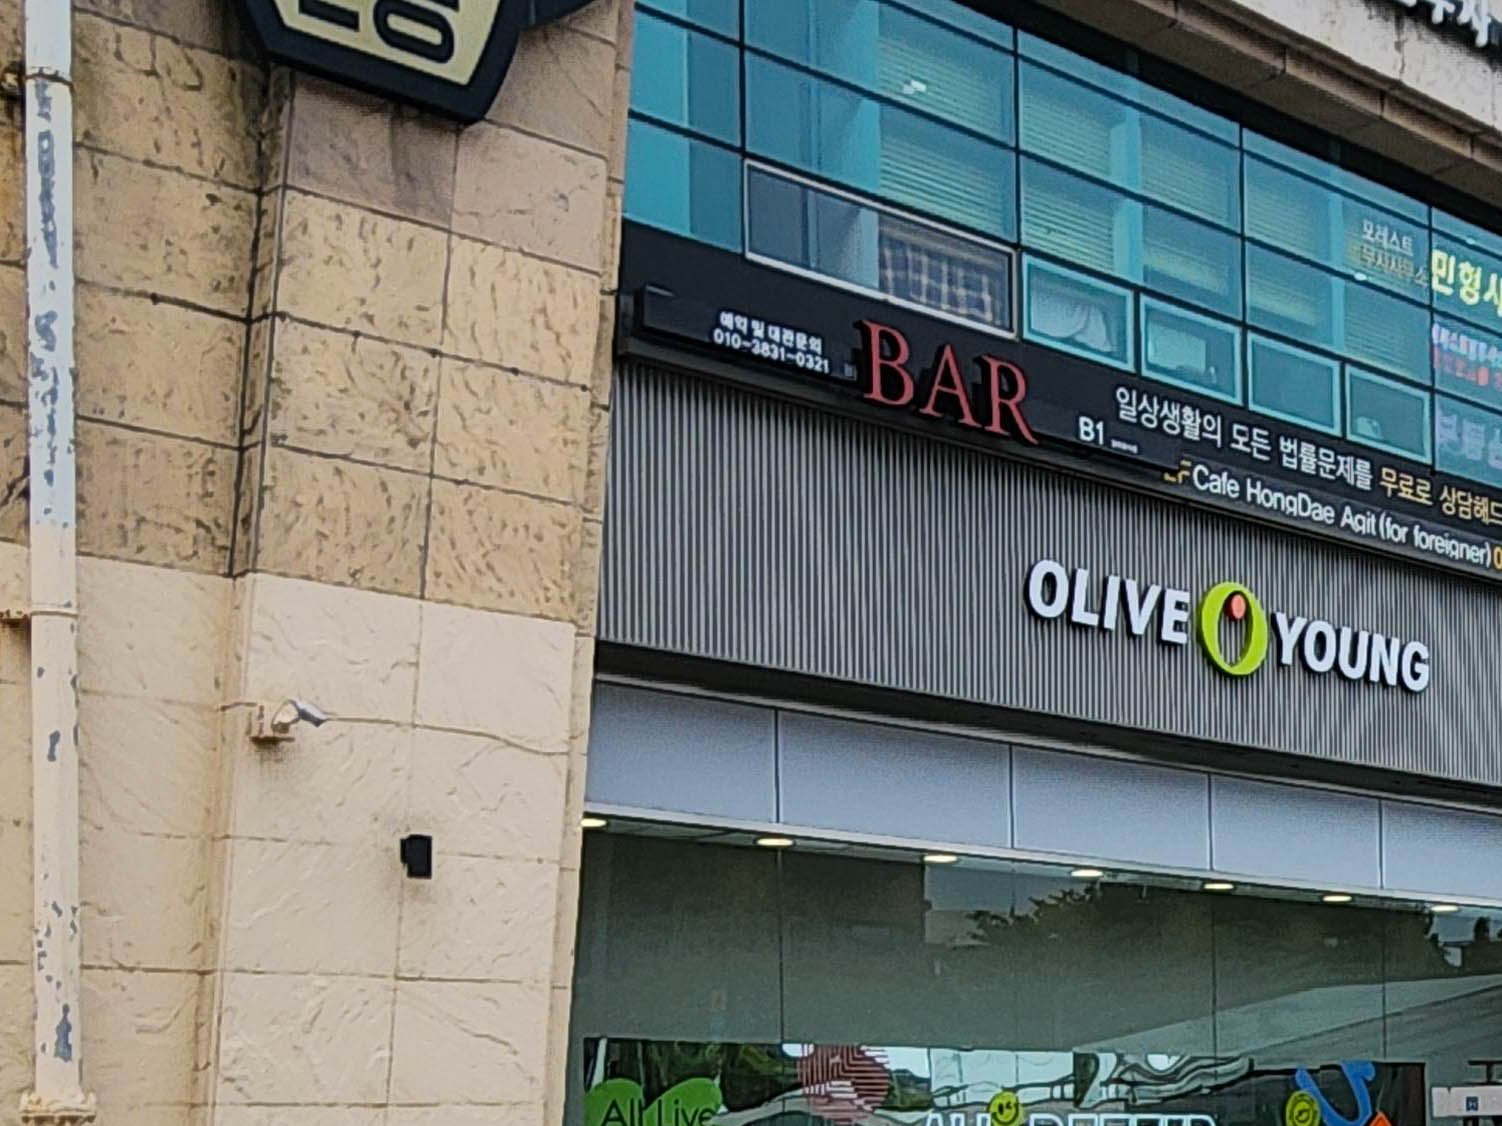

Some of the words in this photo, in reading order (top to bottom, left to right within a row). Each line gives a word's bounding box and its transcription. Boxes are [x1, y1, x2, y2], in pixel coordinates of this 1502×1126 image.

[713, 328, 829, 374] 010-3831-0321
[863, 319, 1039, 445] BAR
[1078, 416, 1104, 445] B1
[1116, 387, 1221, 448] 일상생활의
[1230, 423, 1272, 461] 모든
[1279, 436, 1372, 491] 법률문제를
[1379, 467, 1433, 506] 무료로
[1192, 464, 1240, 499] Cafe
[1246, 478, 1335, 524] HongDae
[1413, 524, 1492, 568] foreigner)
[1028, 558, 1192, 646] OLIVE
[1274, 611, 1431, 693] YOUNG
